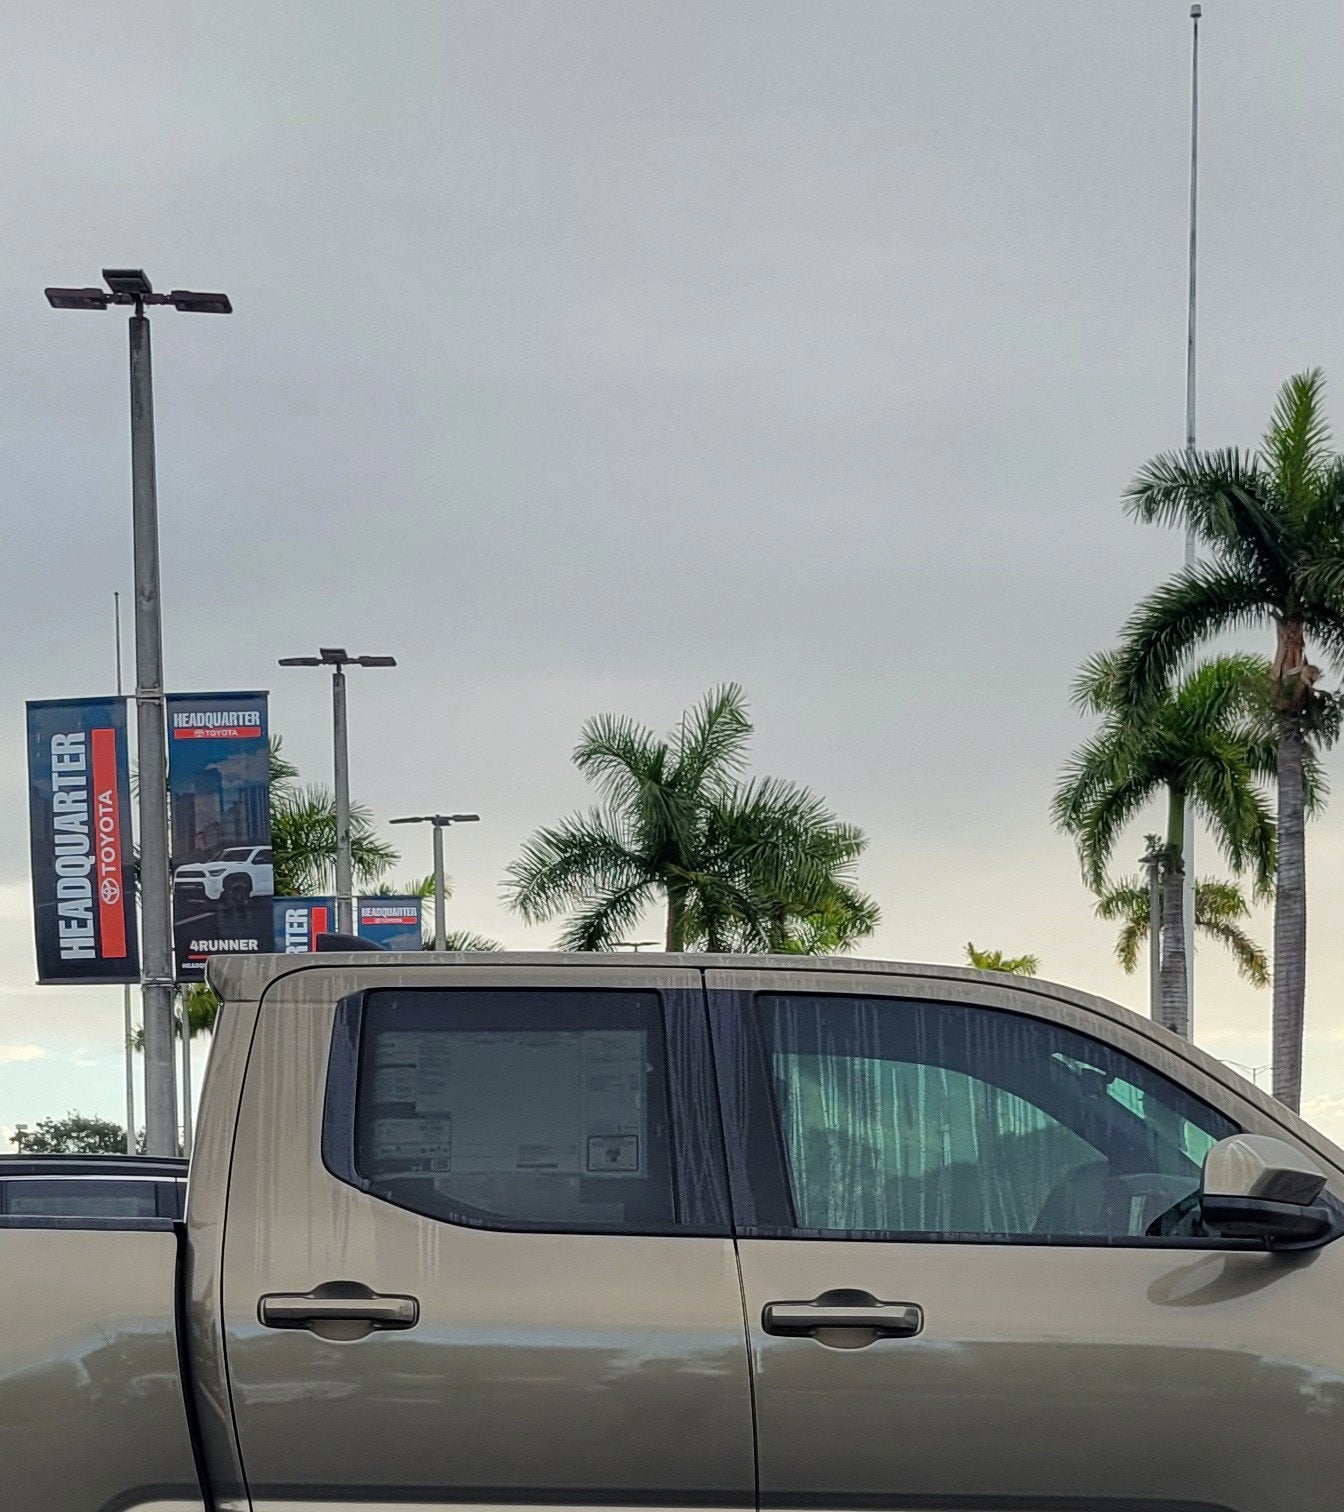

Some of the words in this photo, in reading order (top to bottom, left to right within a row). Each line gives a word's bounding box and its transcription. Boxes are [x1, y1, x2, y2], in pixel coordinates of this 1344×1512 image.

[174, 711, 261, 728] HEADQUARTER
[51, 731, 96, 960] HEADQUARTER
[98, 789, 117, 876] TOYOTA
[189, 939, 259, 951] 4RUNNER
